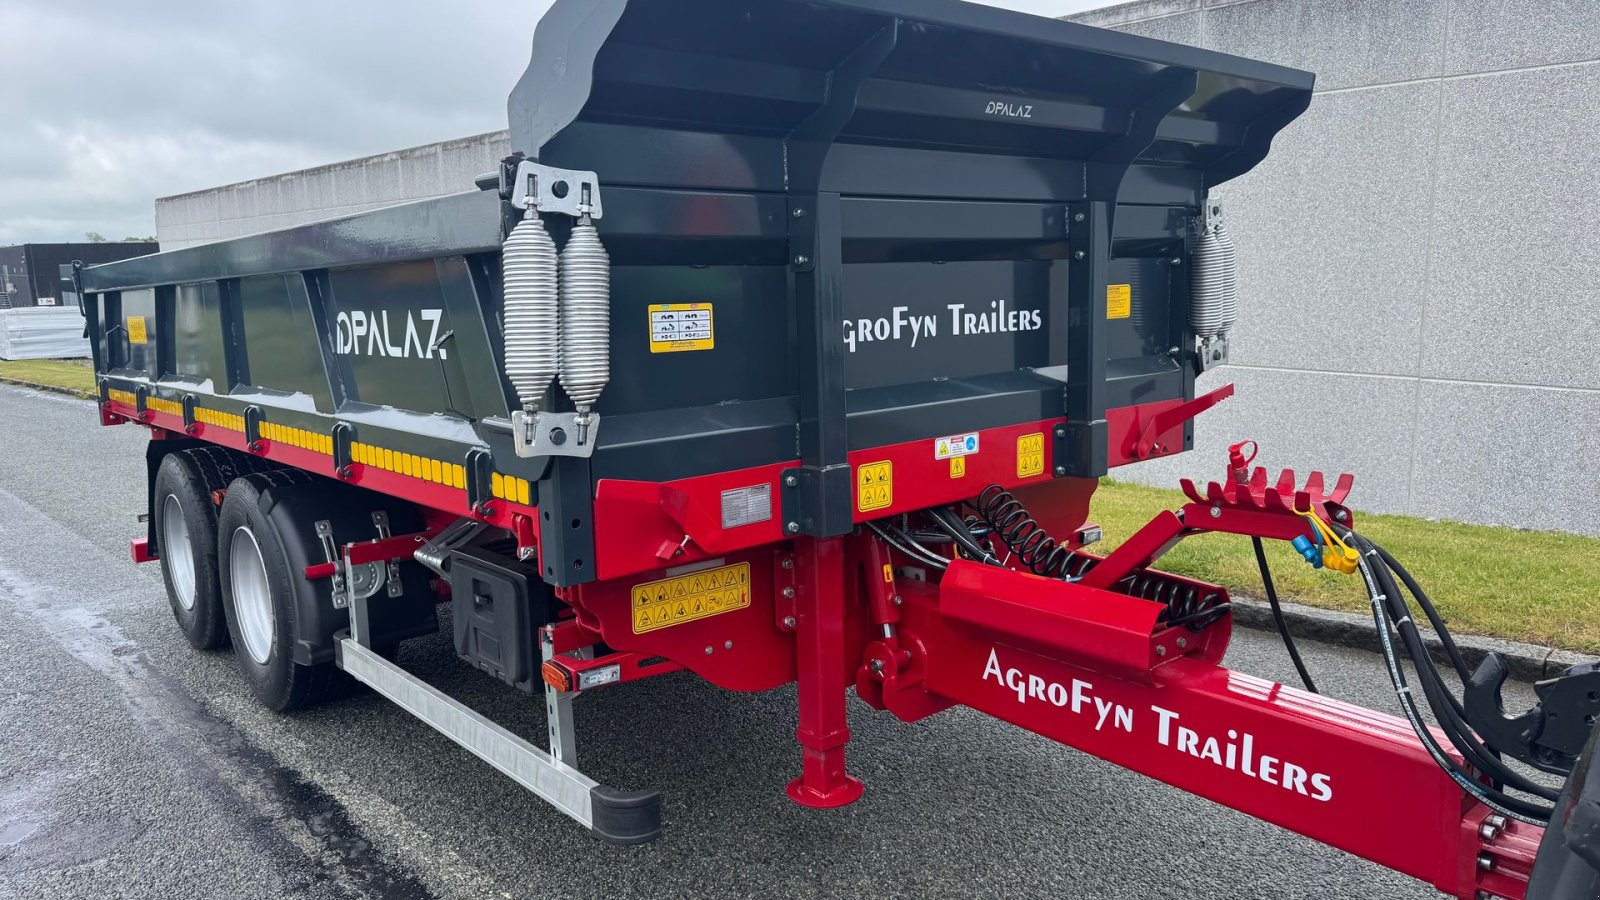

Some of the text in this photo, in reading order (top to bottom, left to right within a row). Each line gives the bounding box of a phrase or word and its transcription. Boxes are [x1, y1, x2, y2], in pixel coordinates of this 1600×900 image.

[843, 306, 937, 353] groFyn
[982, 647, 1333, 802] AgroFyn Trailers
